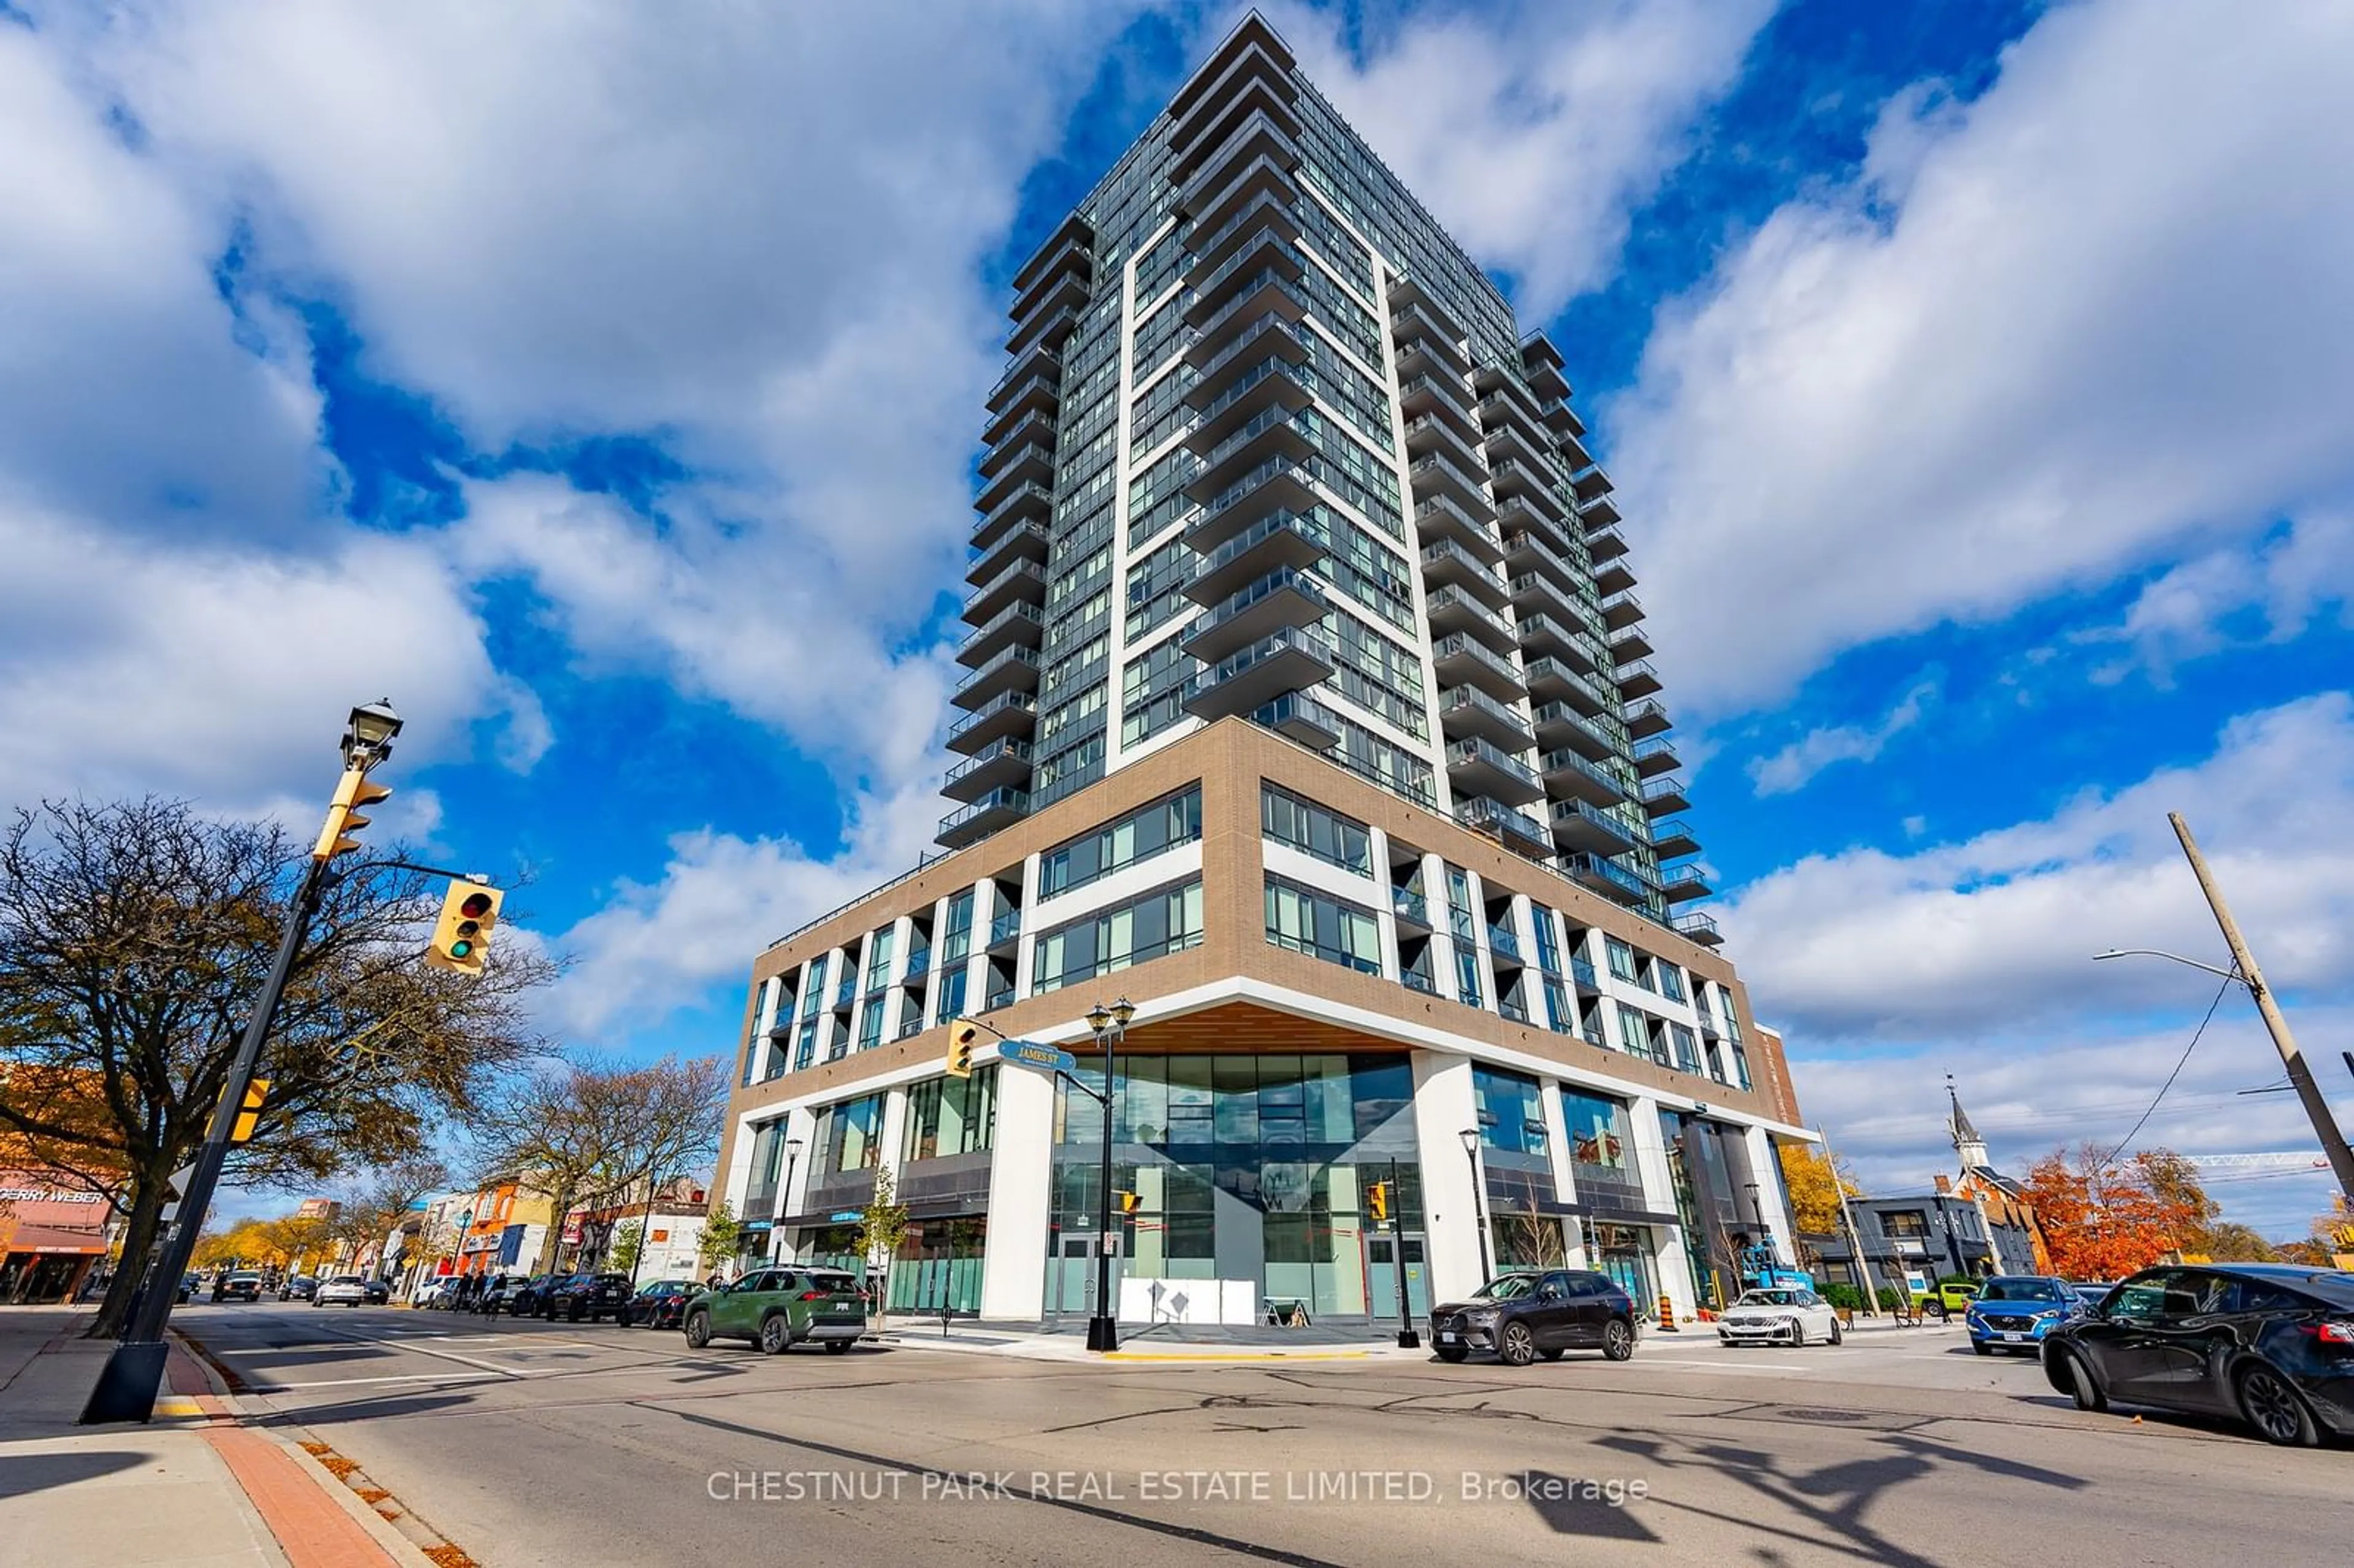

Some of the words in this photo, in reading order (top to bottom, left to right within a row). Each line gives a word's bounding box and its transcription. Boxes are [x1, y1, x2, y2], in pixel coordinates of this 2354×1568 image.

[1018, 1047, 1048, 1062] JAMES
[1047, 1053, 1060, 1065] ST
[50, 1191, 104, 1203] WEBER
